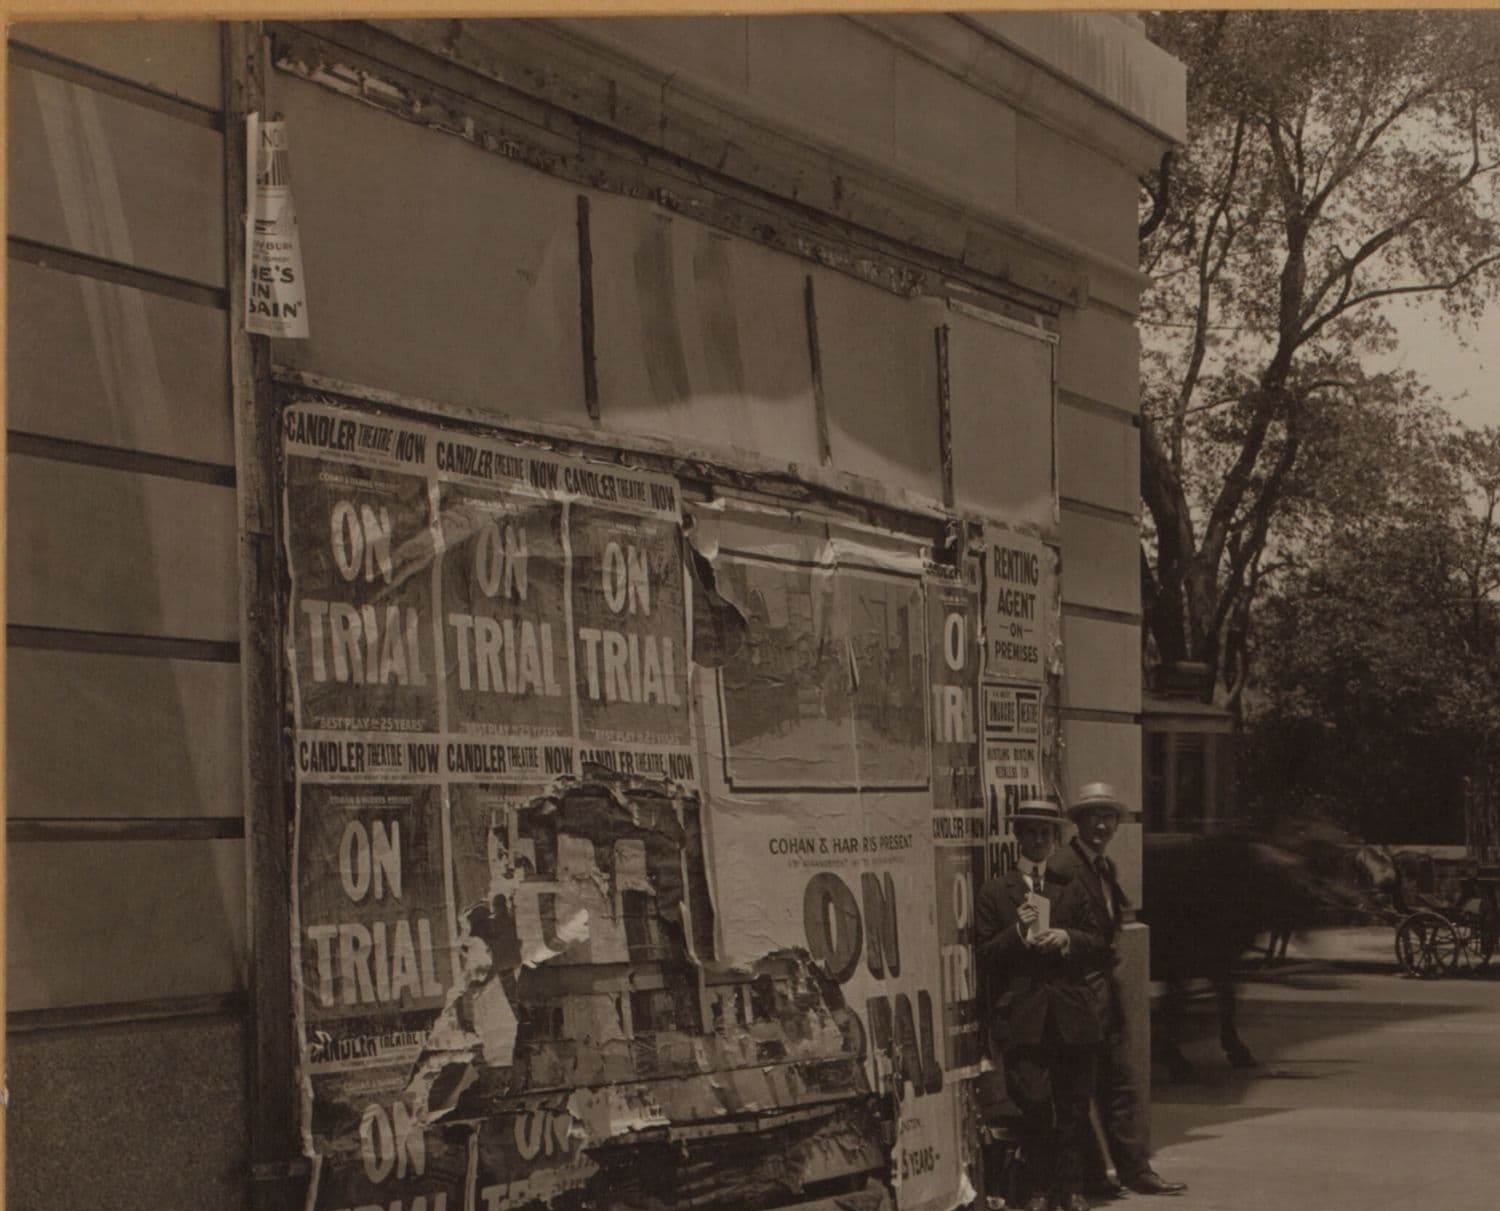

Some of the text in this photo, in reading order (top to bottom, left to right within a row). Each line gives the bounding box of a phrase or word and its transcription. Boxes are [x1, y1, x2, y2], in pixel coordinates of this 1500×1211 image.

[286, 411, 357, 451] CANDLER
[359, 423, 394, 451] THEATRE
[395, 430, 427, 463] NOW
[436, 441, 492, 479] CANDLER
[529, 459, 558, 490] NOW
[564, 466, 676, 512] CANDLER THEATRE NOW
[331, 500, 392, 584] ON
[476, 521, 528, 600] ON
[994, 544, 1040, 586] RENTING
[602, 541, 650, 616] ON
[998, 587, 1036, 621] AGENT
[300, 598, 427, 686] TRIAL
[448, 613, 562, 696] TRIAL
[995, 641, 1038, 664] PREMISES
[1010, 622, 1023, 638] ON
[579, 627, 682, 705] TRIAL
[300, 741, 440, 774] CANDLER THEATRE NOW
[447, 743, 573, 774] CANDLER THEATRE NOW
[634, 751, 664, 773] THEATRE
[668, 752, 695, 780] NOW
[339, 820, 402, 902] ON
[769, 838, 815, 855] COHAN
[819, 838, 829, 853] &
[879, 834, 913, 850] PRESENT
[803, 871, 900, 984] ON
[307, 918, 443, 1008] TRIAL
[359, 1101, 425, 1185] ON
